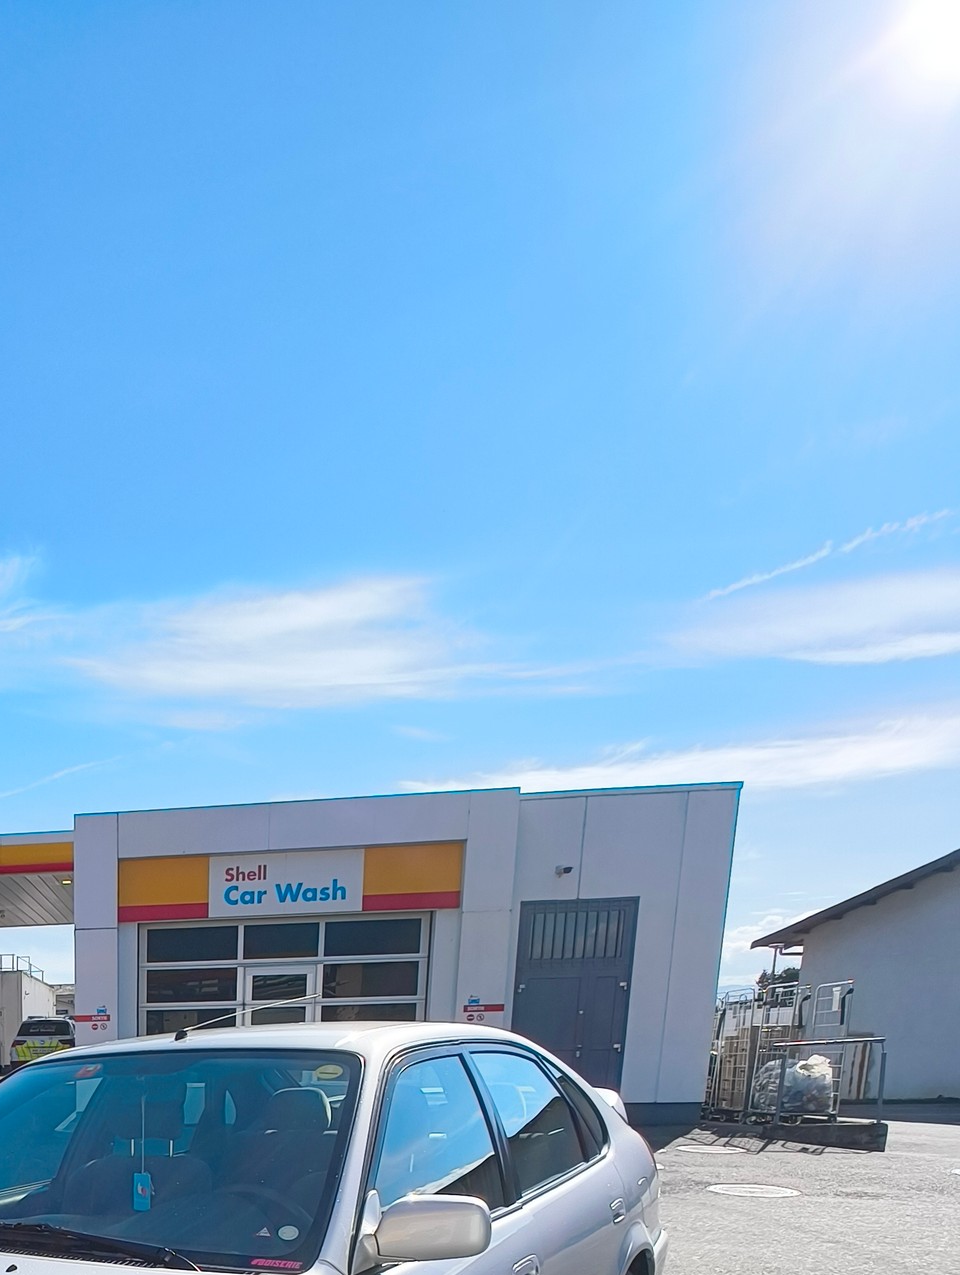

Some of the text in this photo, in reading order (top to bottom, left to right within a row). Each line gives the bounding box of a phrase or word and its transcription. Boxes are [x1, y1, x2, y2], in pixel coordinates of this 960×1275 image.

[225, 864, 268, 882] Shell
[223, 878, 347, 906] Car Wash
